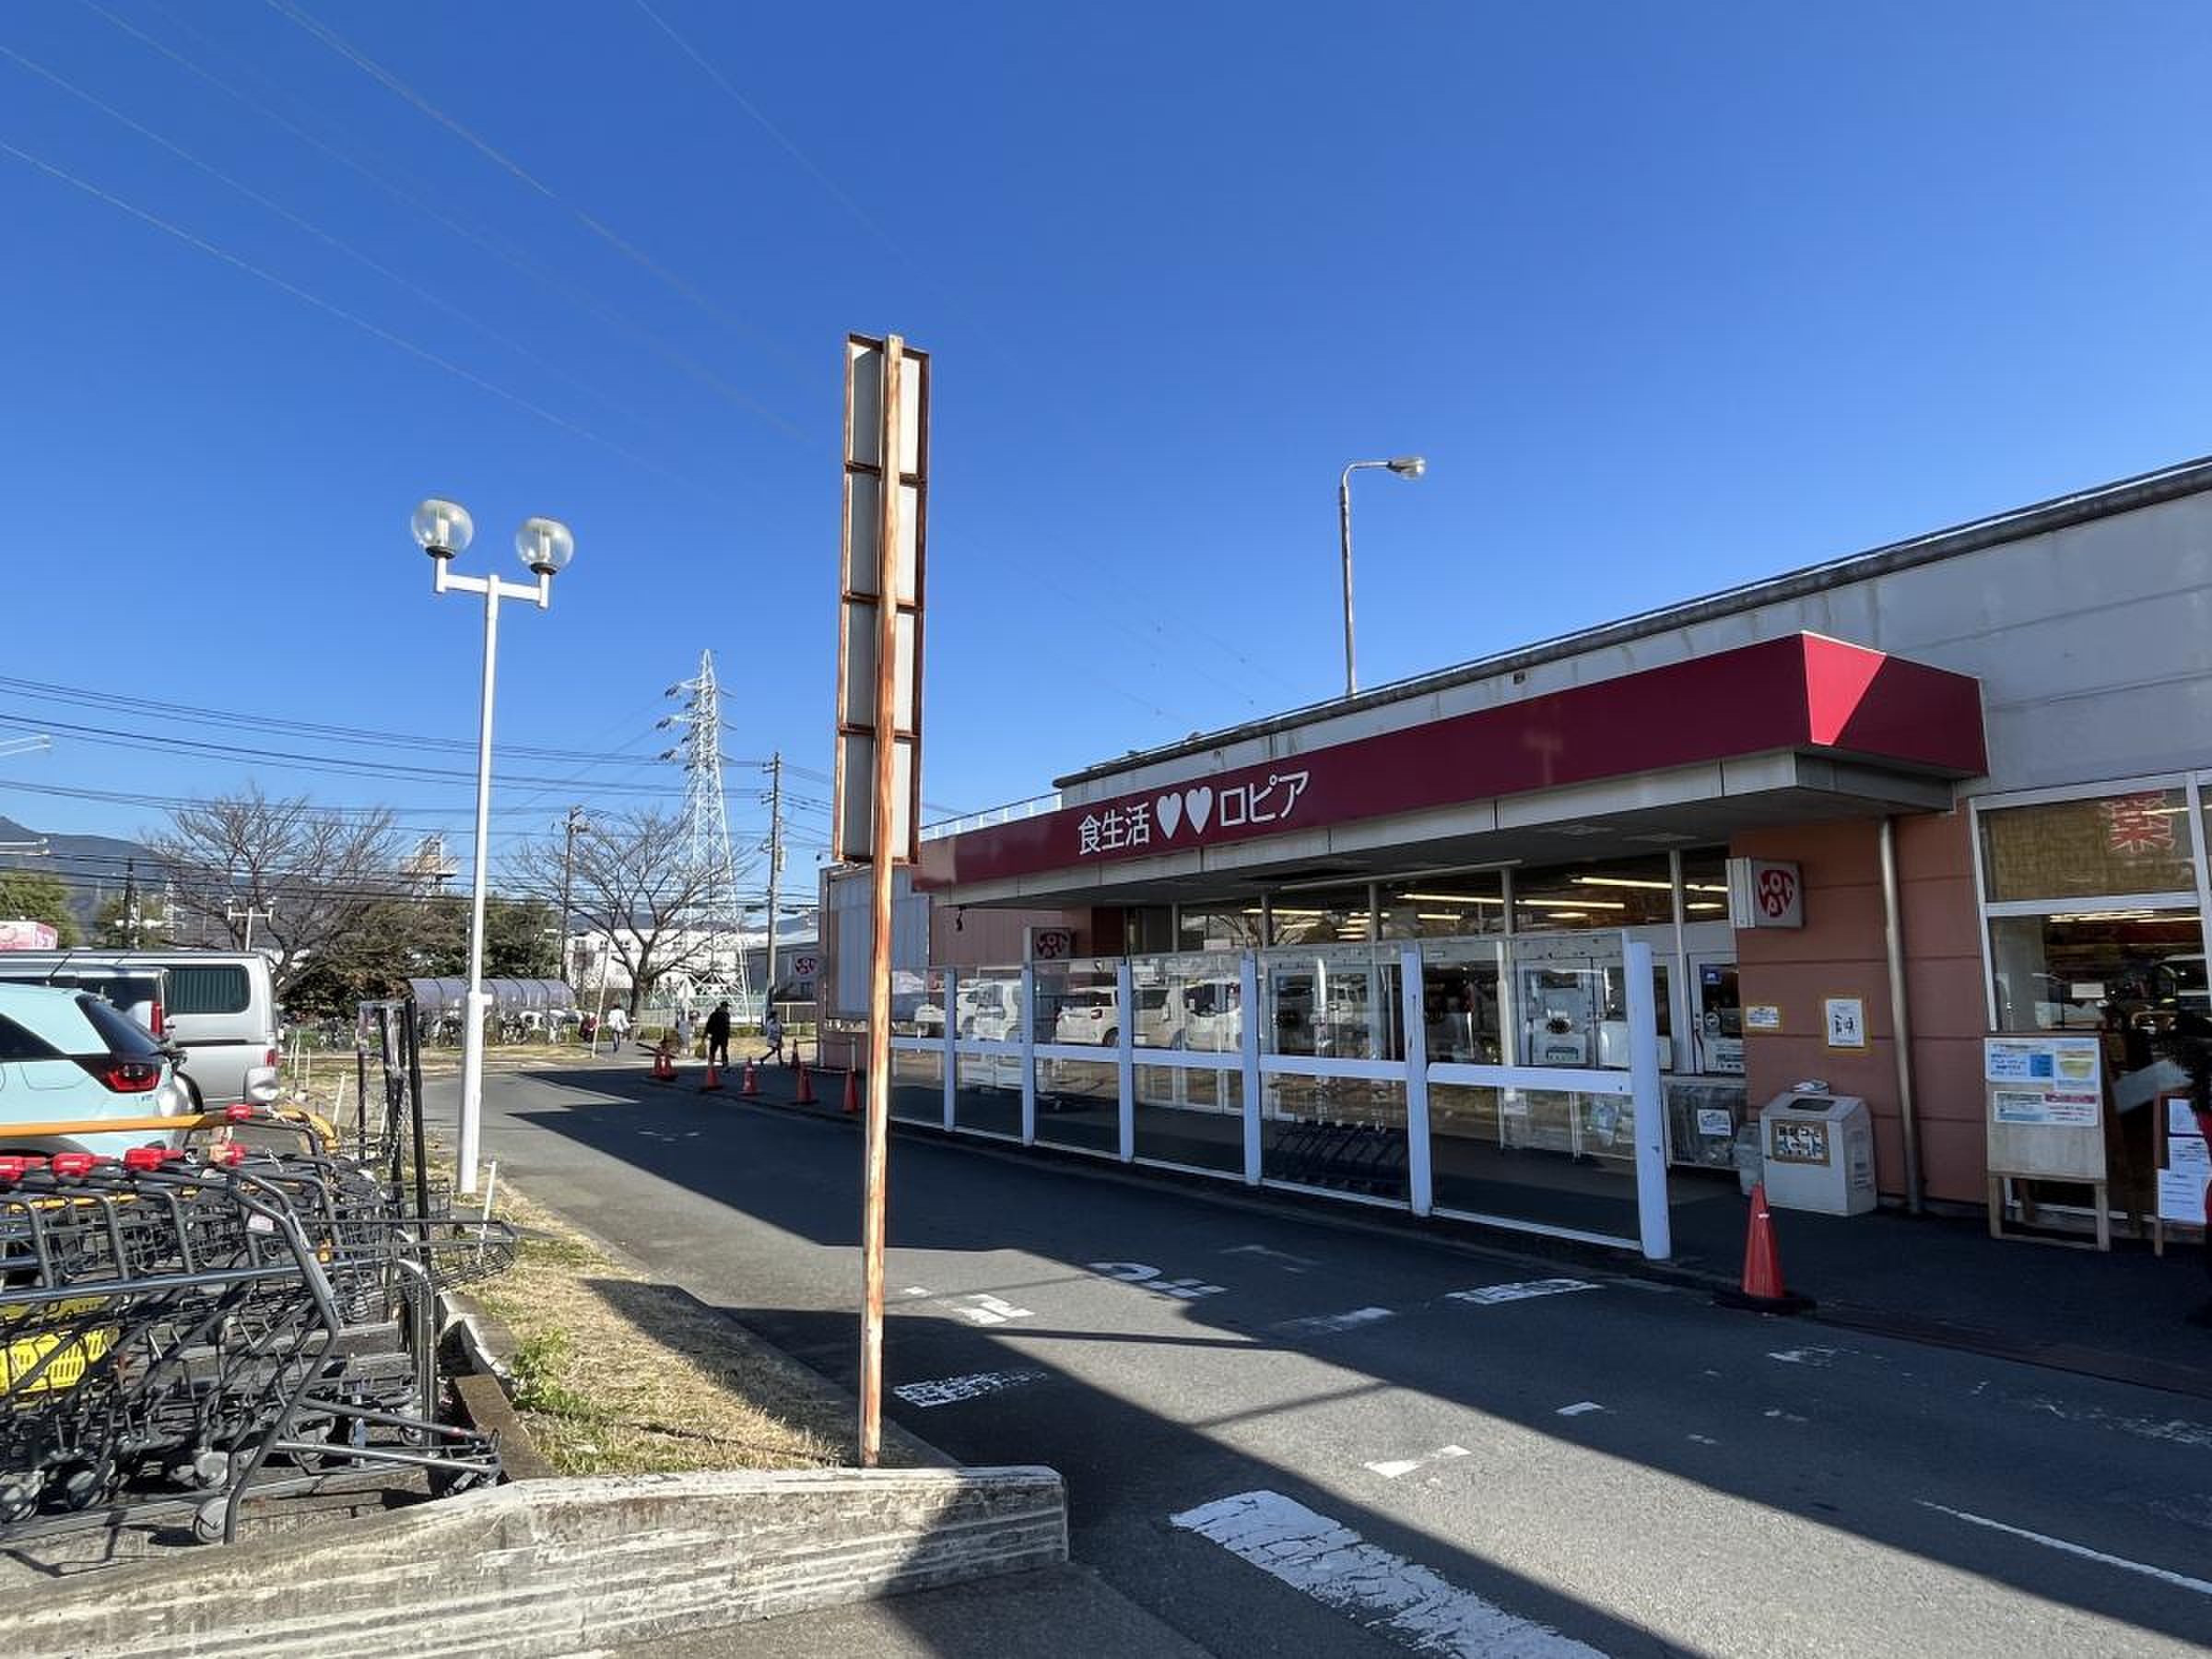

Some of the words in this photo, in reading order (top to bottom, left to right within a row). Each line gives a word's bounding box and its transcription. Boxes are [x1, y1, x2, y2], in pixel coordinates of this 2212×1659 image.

[1077, 801, 1150, 856] 食生活
[1219, 771, 1309, 828] ロピア
